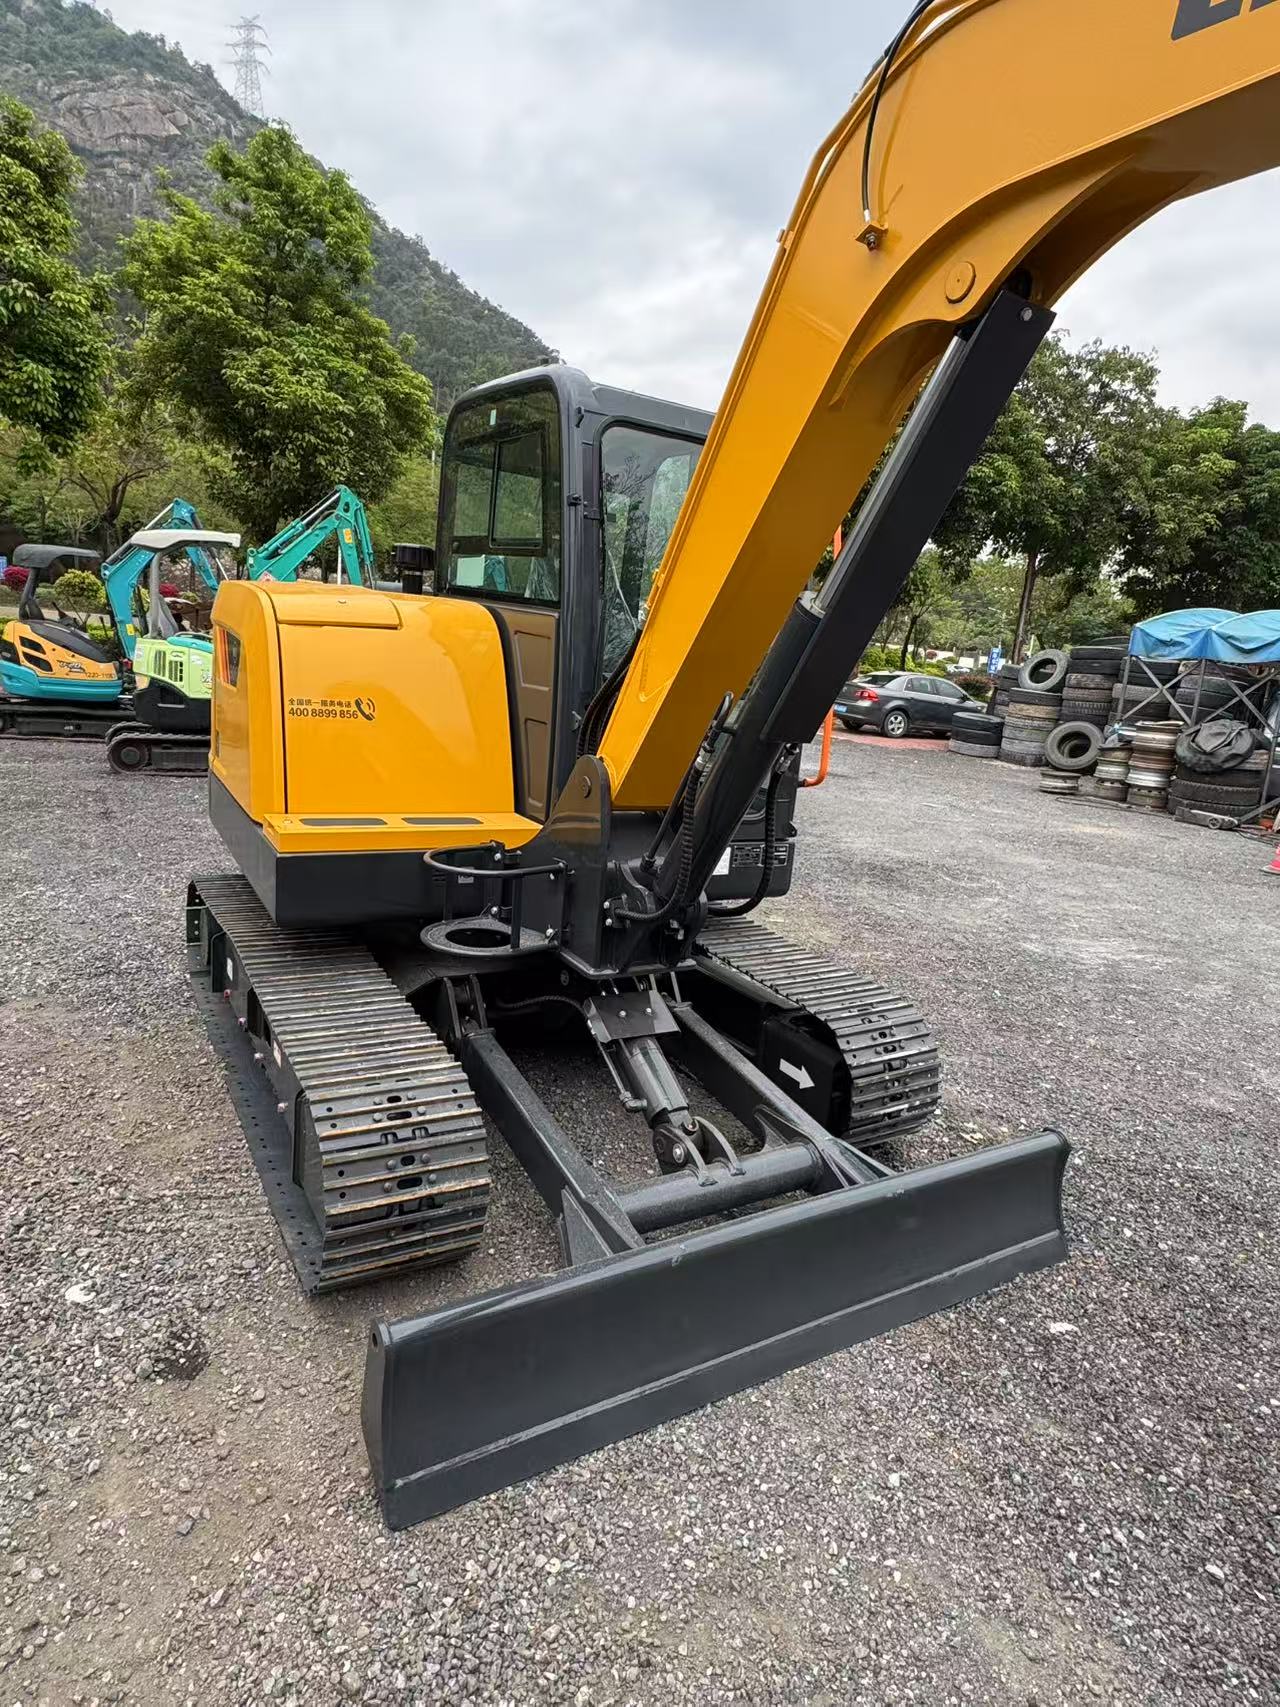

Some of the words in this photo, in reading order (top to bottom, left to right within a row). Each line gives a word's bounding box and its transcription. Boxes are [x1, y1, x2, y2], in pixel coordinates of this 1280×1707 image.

[288, 697, 352, 708] 全国统一服务电话
[288, 707, 309, 717] 400
[310, 708, 338, 718] 8899
[338, 709, 359, 719] 856
